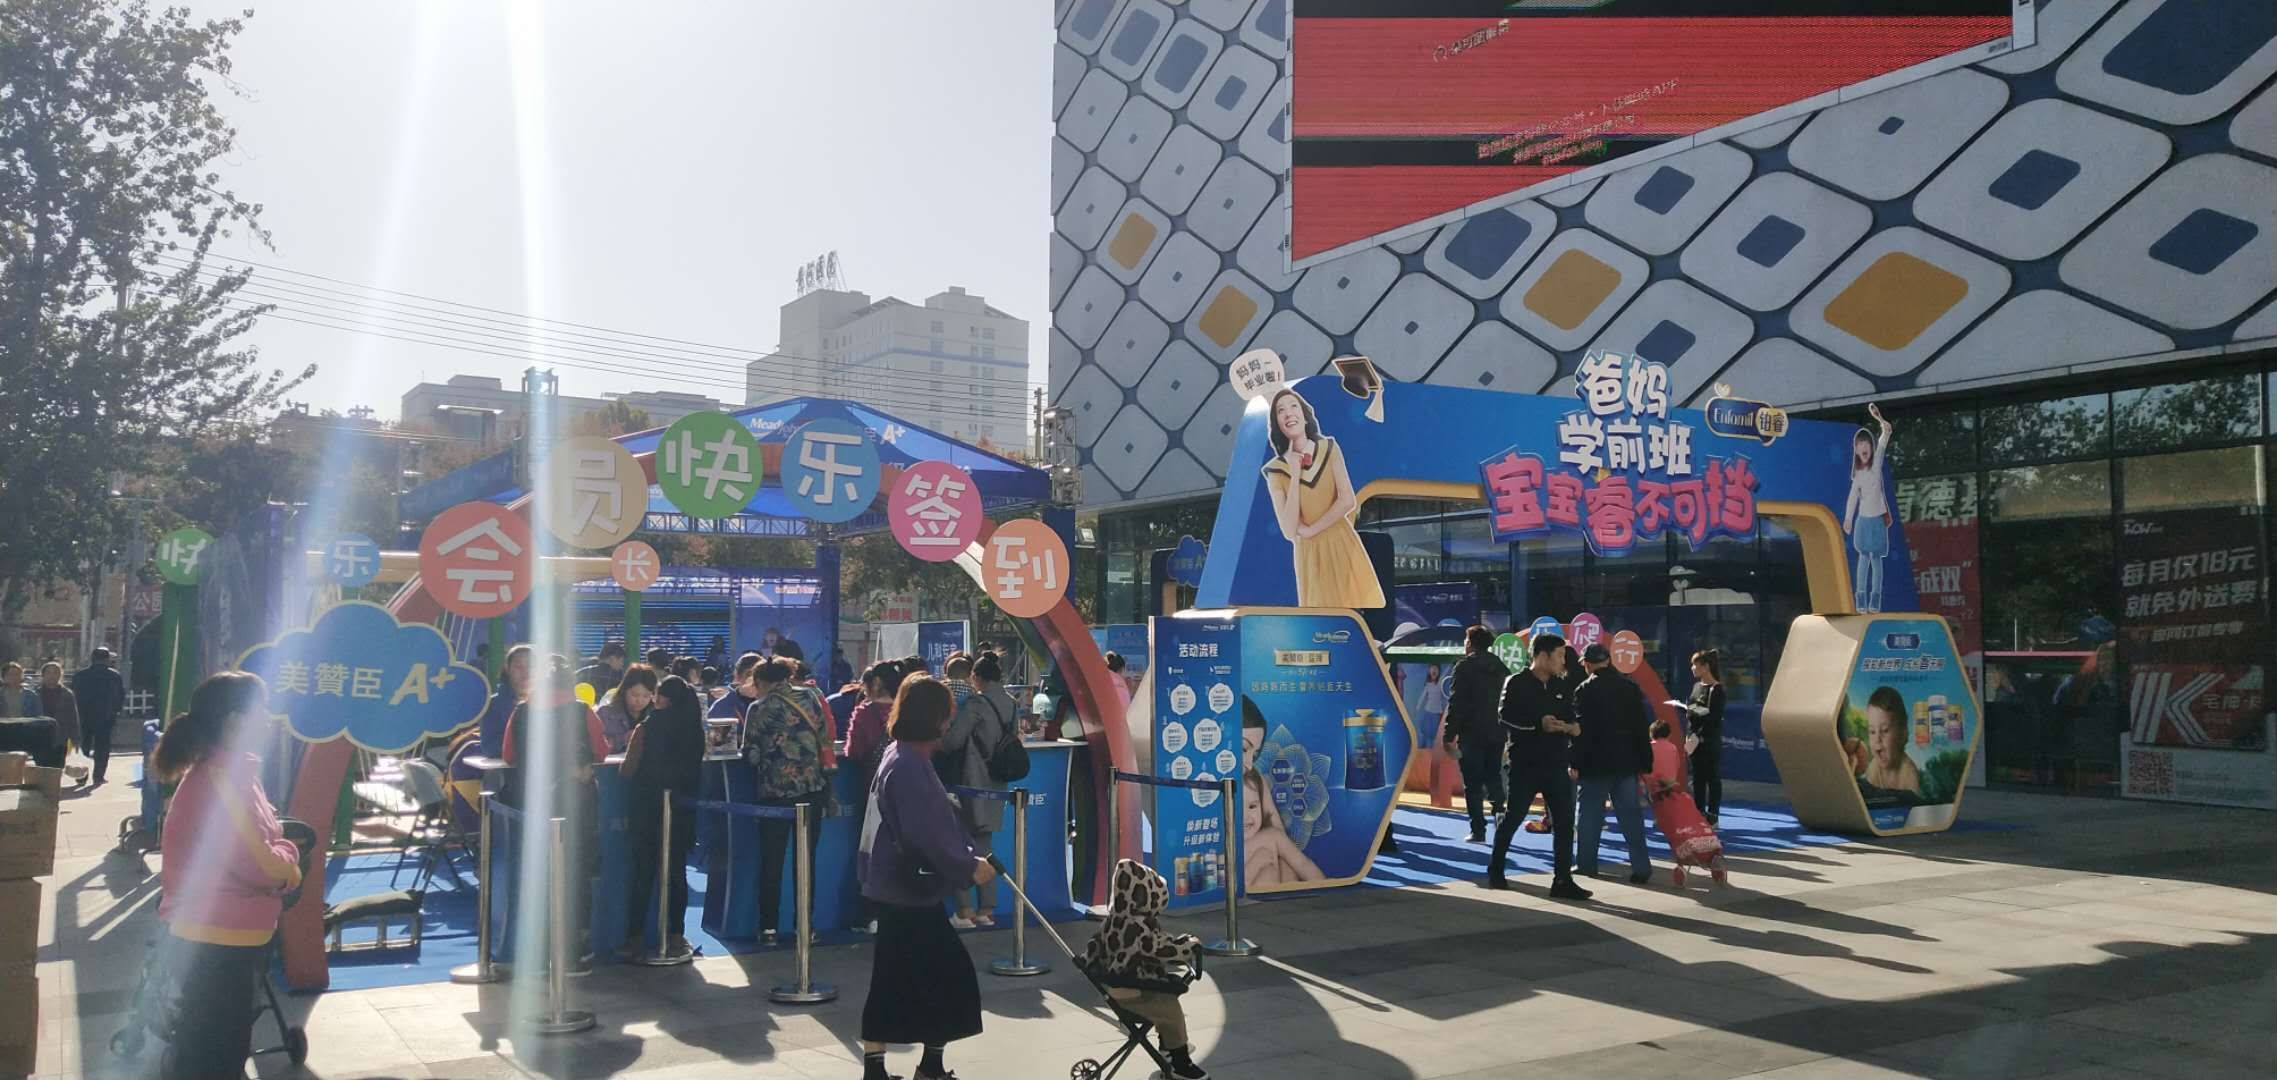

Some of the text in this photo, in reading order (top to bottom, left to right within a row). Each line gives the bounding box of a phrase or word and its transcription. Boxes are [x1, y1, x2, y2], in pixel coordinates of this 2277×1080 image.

[1583, 354, 1668, 419] 爸妈
[1559, 413, 1692, 476] 学前班
[1485, 452, 1756, 548] 宝宝睿不可挡
[2121, 546, 2256, 587] 每月仅18元
[1178, 643, 1219, 658] 活动流程
[389, 663, 456, 706] A+
